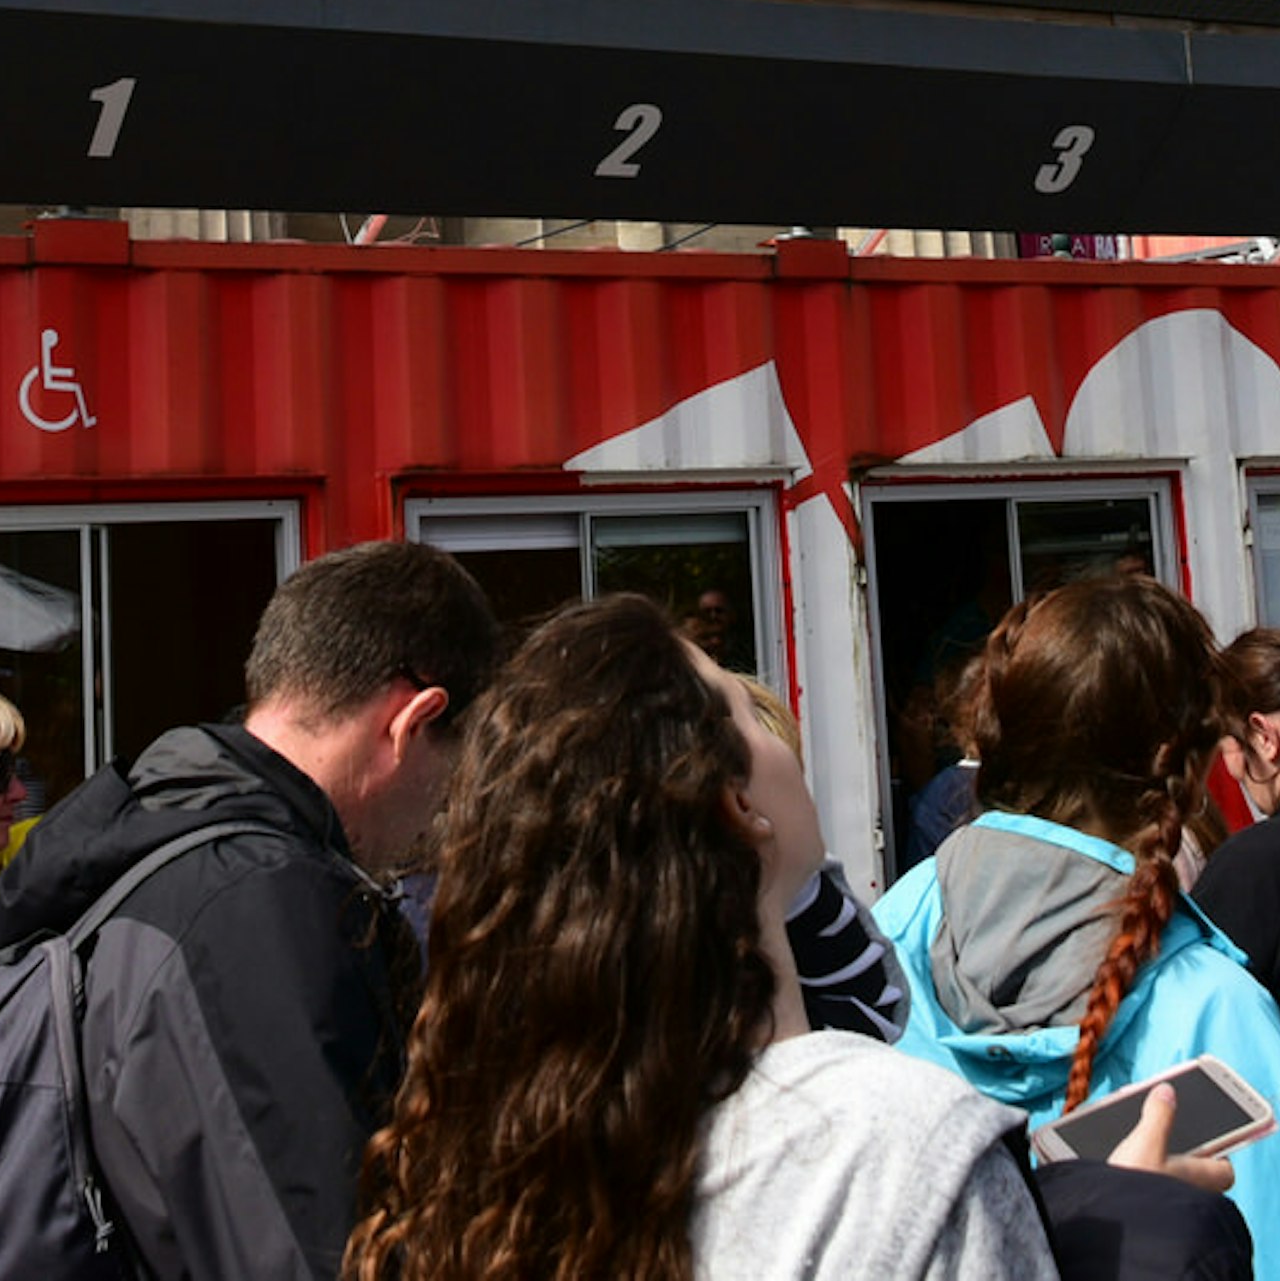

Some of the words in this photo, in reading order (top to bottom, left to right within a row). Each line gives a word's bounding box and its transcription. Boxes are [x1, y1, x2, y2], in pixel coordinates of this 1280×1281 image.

[88, 78, 135, 157] 1
[595, 104, 662, 177] 2
[1035, 126, 1094, 192] 3
